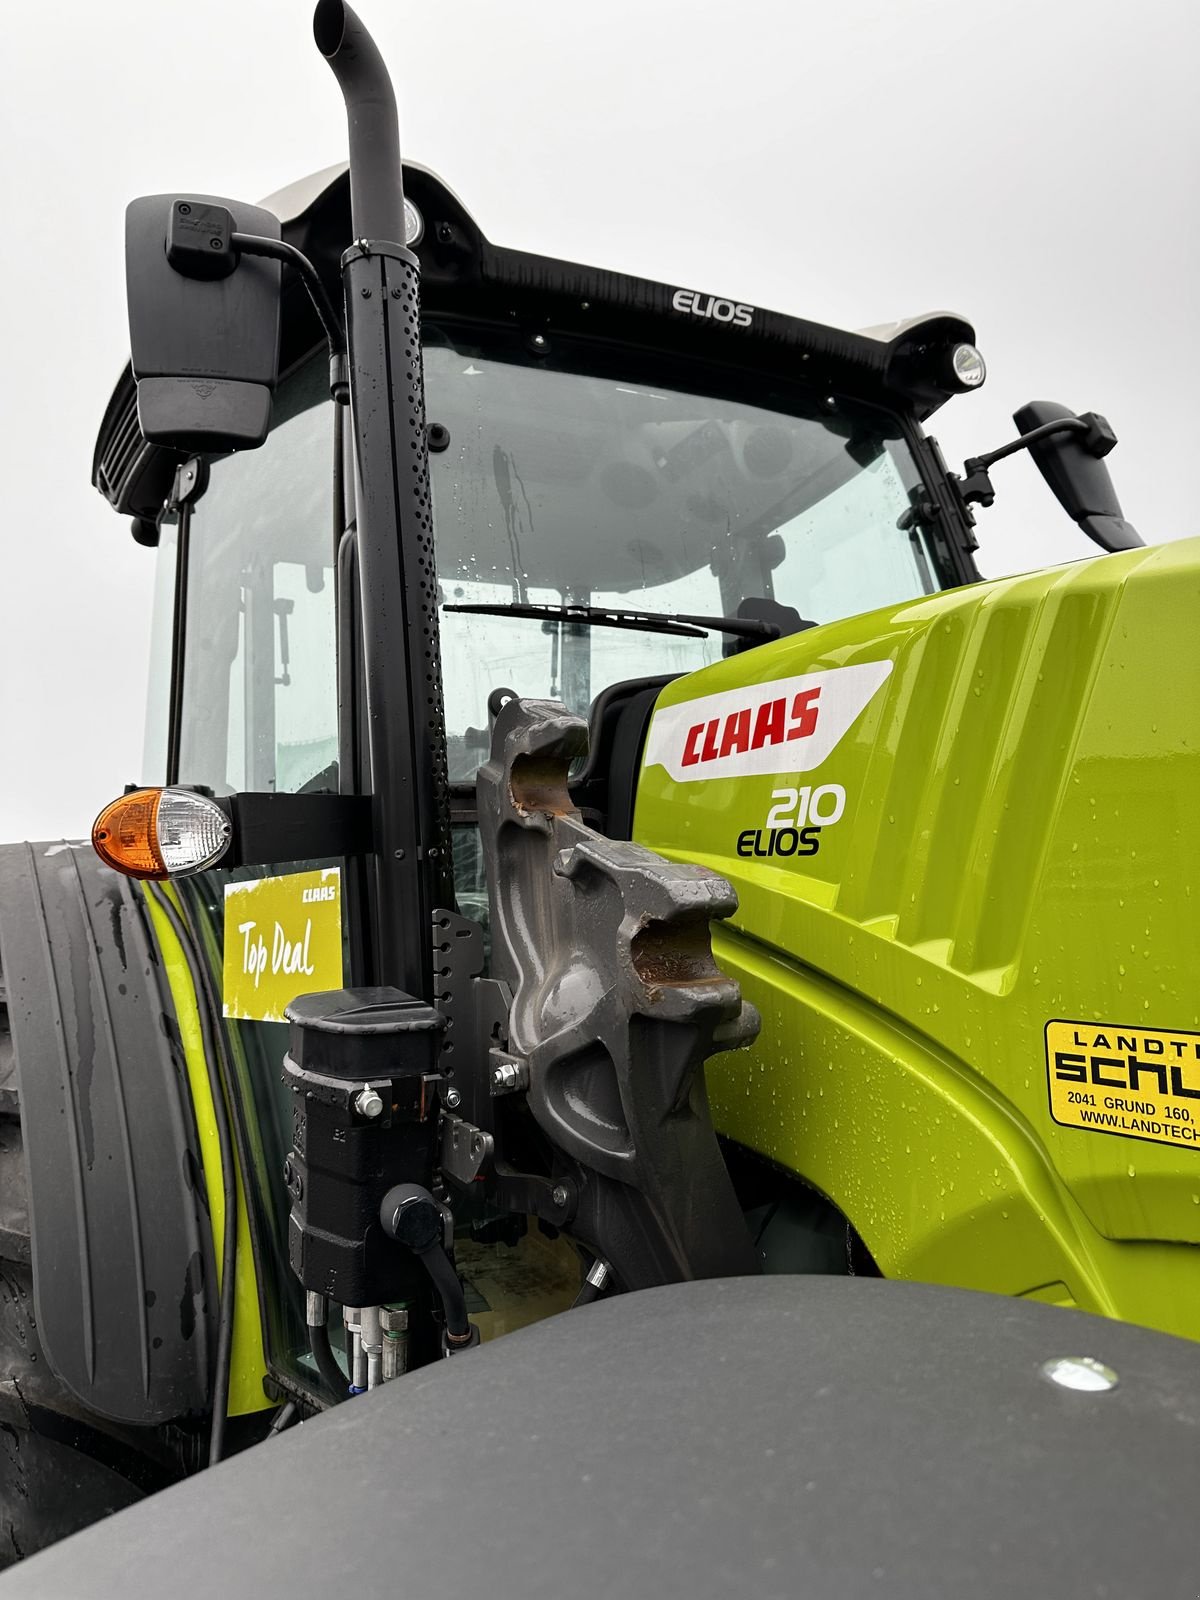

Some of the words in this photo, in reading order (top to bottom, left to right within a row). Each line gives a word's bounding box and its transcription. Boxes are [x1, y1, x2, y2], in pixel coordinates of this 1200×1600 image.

[672, 289, 754, 327] ELIOS
[681, 686, 822, 768] CLAAS
[766, 783, 847, 829] 210
[736, 826, 822, 857] ELIOS
[302, 885, 335, 904] CLAAS
[238, 921, 268, 989] Top
[271, 920, 315, 976] Deal
[1067, 1091, 1097, 1107] 2041
[1103, 1096, 1156, 1116] GRUND
[1164, 1105, 1195, 1125] 160,
